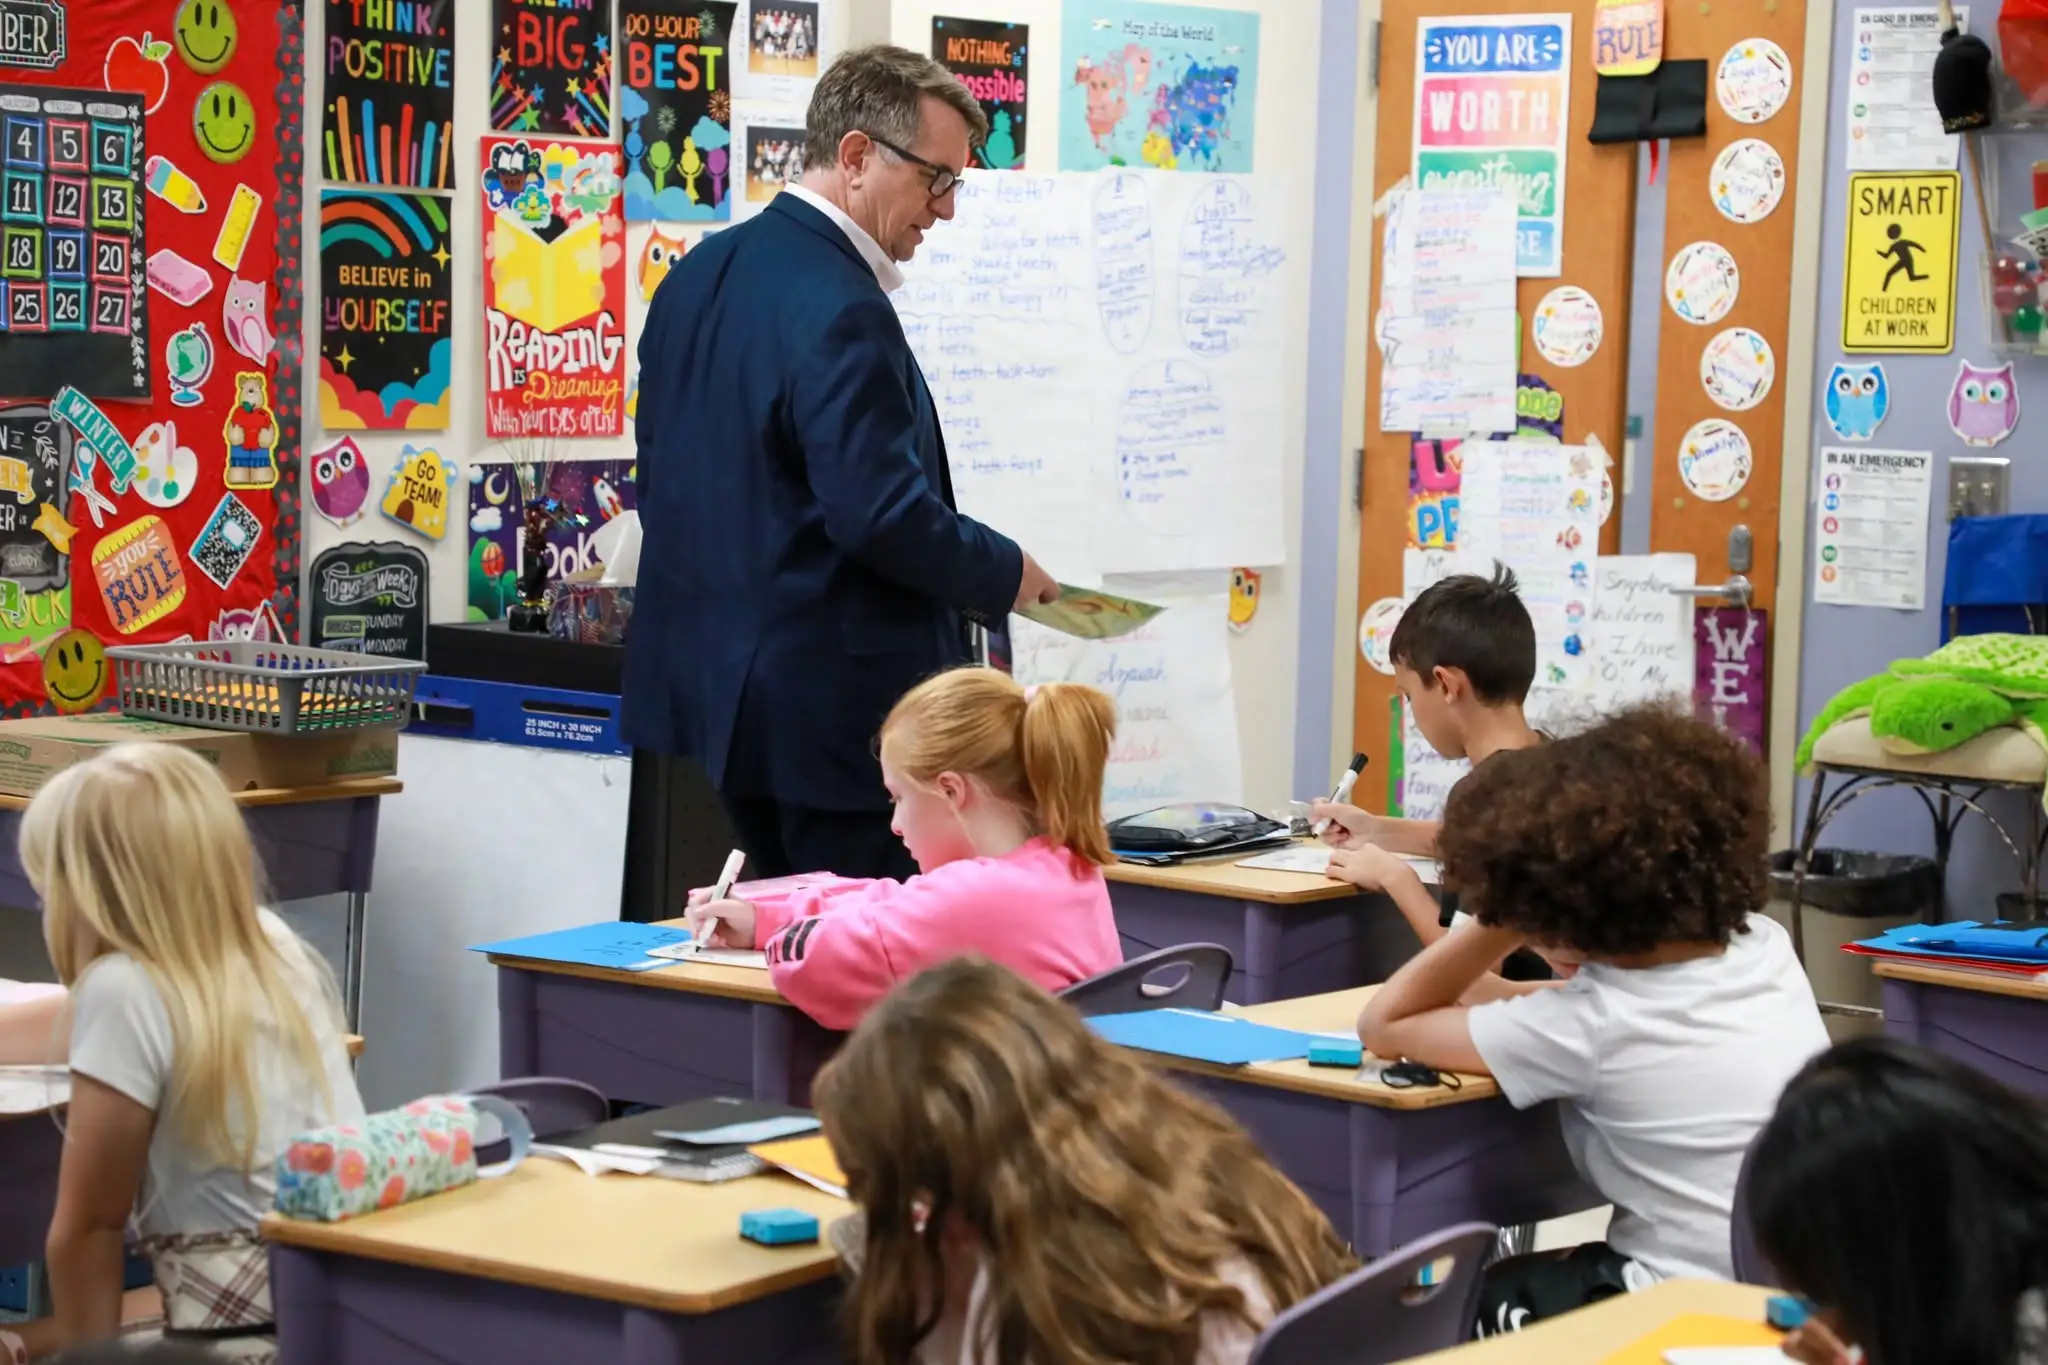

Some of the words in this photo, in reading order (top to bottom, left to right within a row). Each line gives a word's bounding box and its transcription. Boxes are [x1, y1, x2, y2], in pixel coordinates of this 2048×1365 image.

[0, 12, 48, 54] BER
[350, 0, 432, 35] THINK
[626, 14, 650, 37] DO
[655, 15, 699, 39] YOUR
[518, 11, 585, 70] BIG
[947, 37, 1012, 66] NOTHING
[1444, 34, 1490, 65] YOU
[1497, 32, 1540, 64] ARE
[1596, 20, 1661, 64] RULE
[329, 36, 451, 88] POSITIVE
[628, 42, 723, 92] BEST
[1428, 90, 1550, 133] WORTH
[17, 127, 32, 158] 4
[62, 129, 78, 159] 5
[104, 136, 118, 162] 6
[13, 181, 31, 213] 11
[56, 184, 79, 216] 12
[102, 188, 125, 218] 13
[1859, 186, 1949, 216] SMART
[10, 237, 32, 268] 18
[55, 239, 78, 270] 19
[99, 244, 123, 273] 20
[339, 265, 408, 288] BELIEVE
[414, 267, 432, 289] in
[15, 295, 39, 322] 25
[55, 293, 79, 320] 26
[99, 296, 122, 323] 27
[325, 297, 448, 333] YOURSELF
[1860, 297, 1937, 314] CHILDREN
[1864, 320, 1882, 336] AT
[1887, 319, 1929, 336] WORK
[522, 371, 622, 414] Dreaming
[68, 396, 128, 471] WINTER
[417, 459, 436, 481] GO
[1828, 452, 1838, 464] IN
[1840, 453, 1856, 465] AN
[1860, 454, 1926, 469] EMERGENCY
[403, 477, 441, 509] TEAM!
[112, 540, 149, 576] you
[104, 546, 181, 625] RULE
[329, 578, 361, 601] Days
[376, 569, 410, 593] Week
[365, 614, 405, 629] SUNDAY
[1593, 602, 1665, 623] hildren
[366, 638, 408, 653] MONDAY
[537, 719, 560, 730] INCH
[580, 723, 602, 735] INCH
